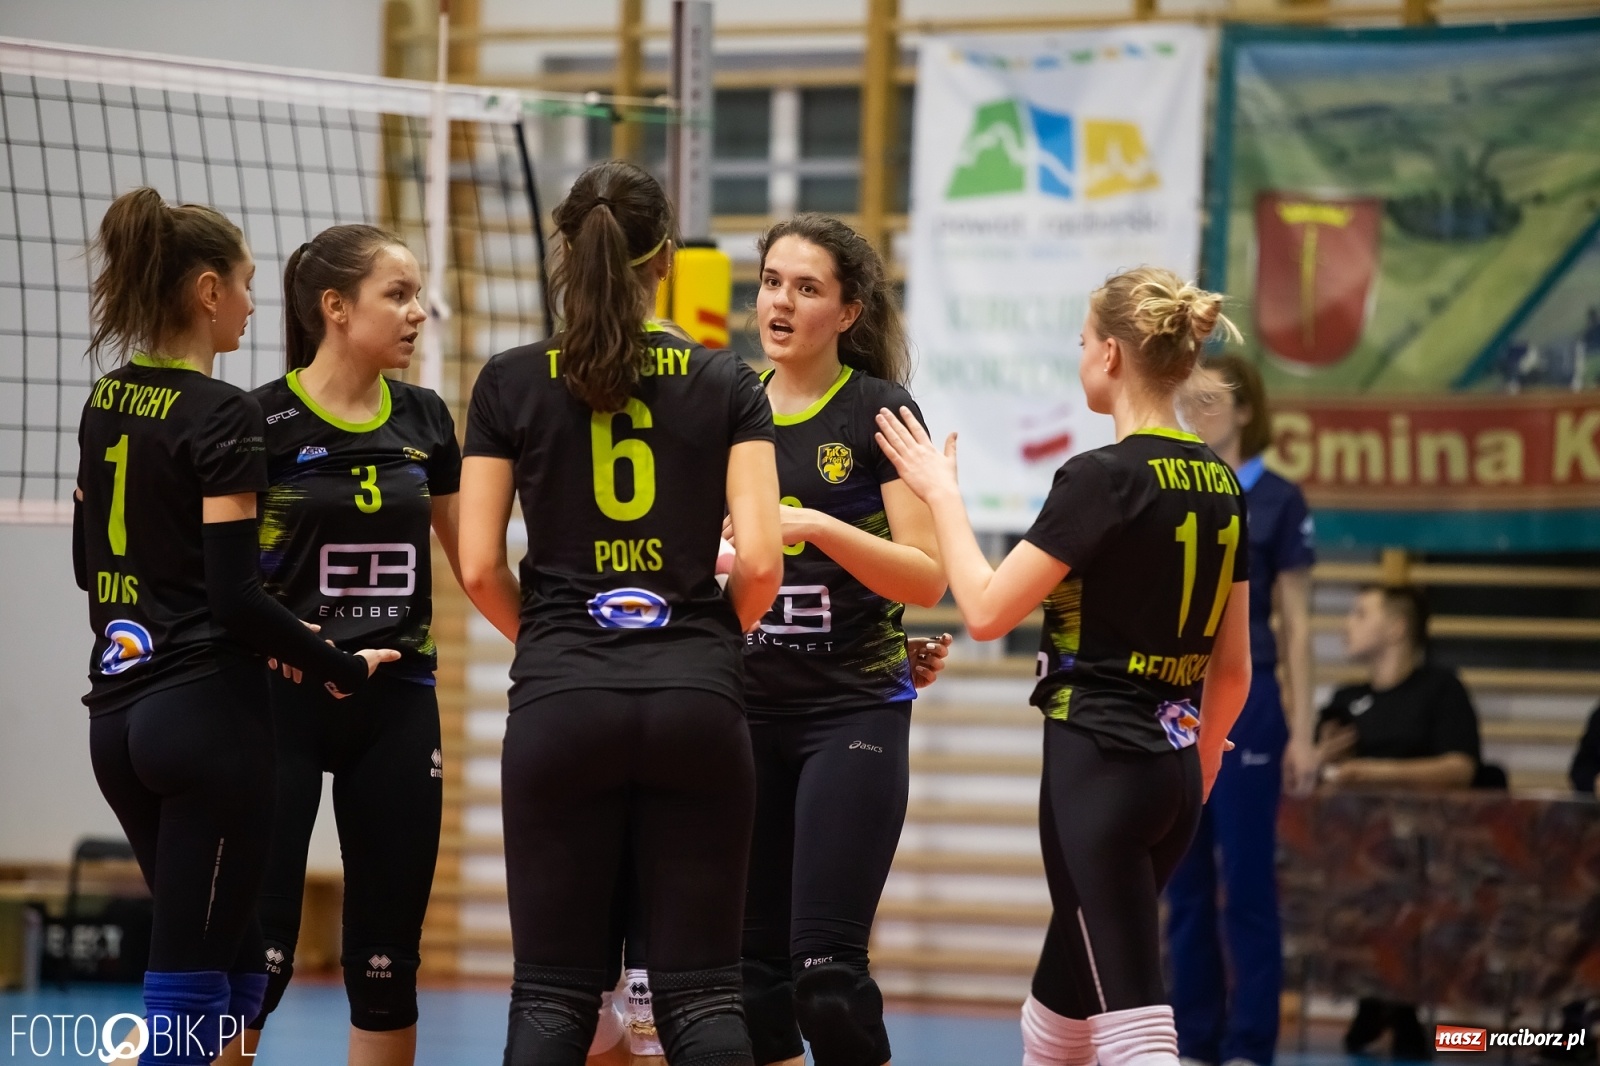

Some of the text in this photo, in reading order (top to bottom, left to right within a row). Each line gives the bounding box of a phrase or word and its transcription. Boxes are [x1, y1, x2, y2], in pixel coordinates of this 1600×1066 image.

[118, 383, 182, 420] TYCHY
[590, 397, 655, 522] 6
[1264, 413, 1523, 484] Gmina
[351, 465, 382, 513] 3
[1147, 458, 1191, 491] TKS
[104, 434, 129, 556] 1
[594, 538, 663, 573] POKS
[1175, 511, 1239, 638] 11
[319, 605, 411, 618] EKOBET
[855, 741, 883, 753] asics
[366, 970, 392, 978] errea
[808, 956, 833, 967] asics
